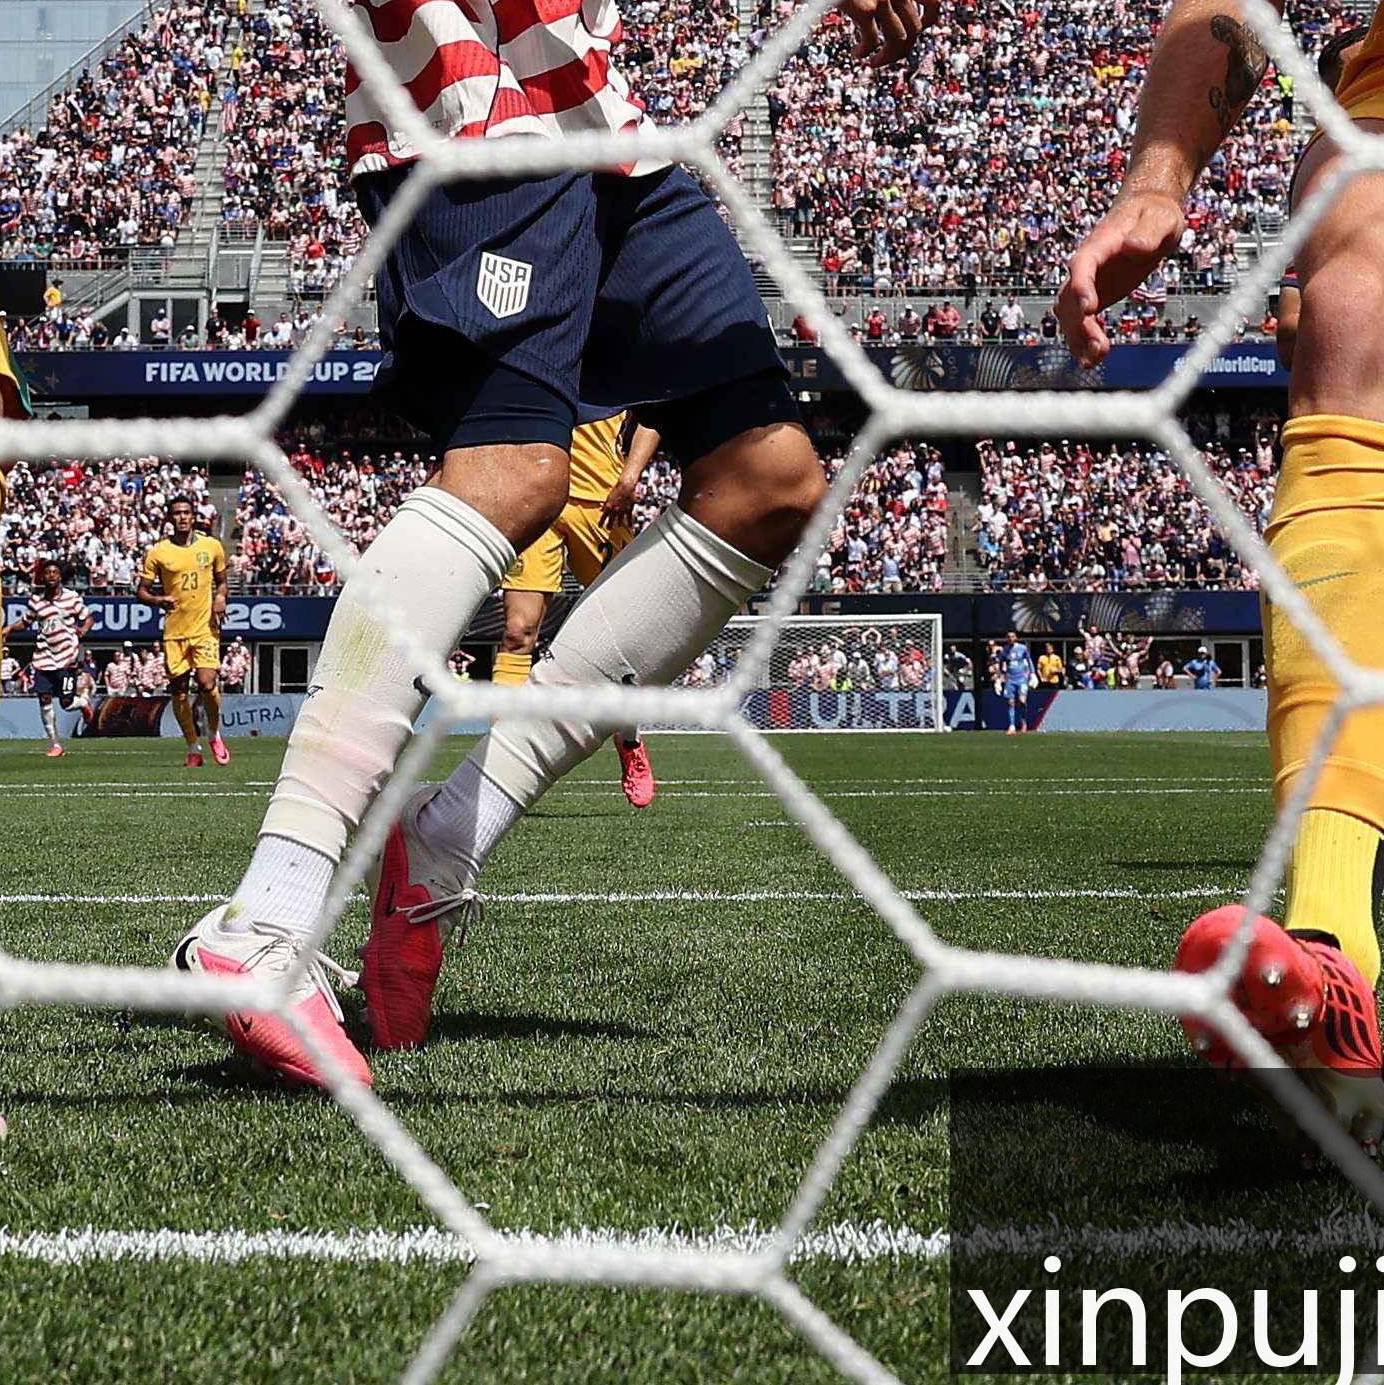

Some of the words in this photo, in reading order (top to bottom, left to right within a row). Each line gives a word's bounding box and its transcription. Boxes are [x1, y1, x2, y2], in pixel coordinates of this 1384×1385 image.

[485, 257, 528, 284] USA
[145, 362, 200, 383] FIFA
[181, 572, 198, 591] 23
[92, 604, 153, 631] CUP
[62, 676, 74, 691] 16
[221, 705, 285, 727] ULTRA
[810, 691, 976, 729] ULTRA
